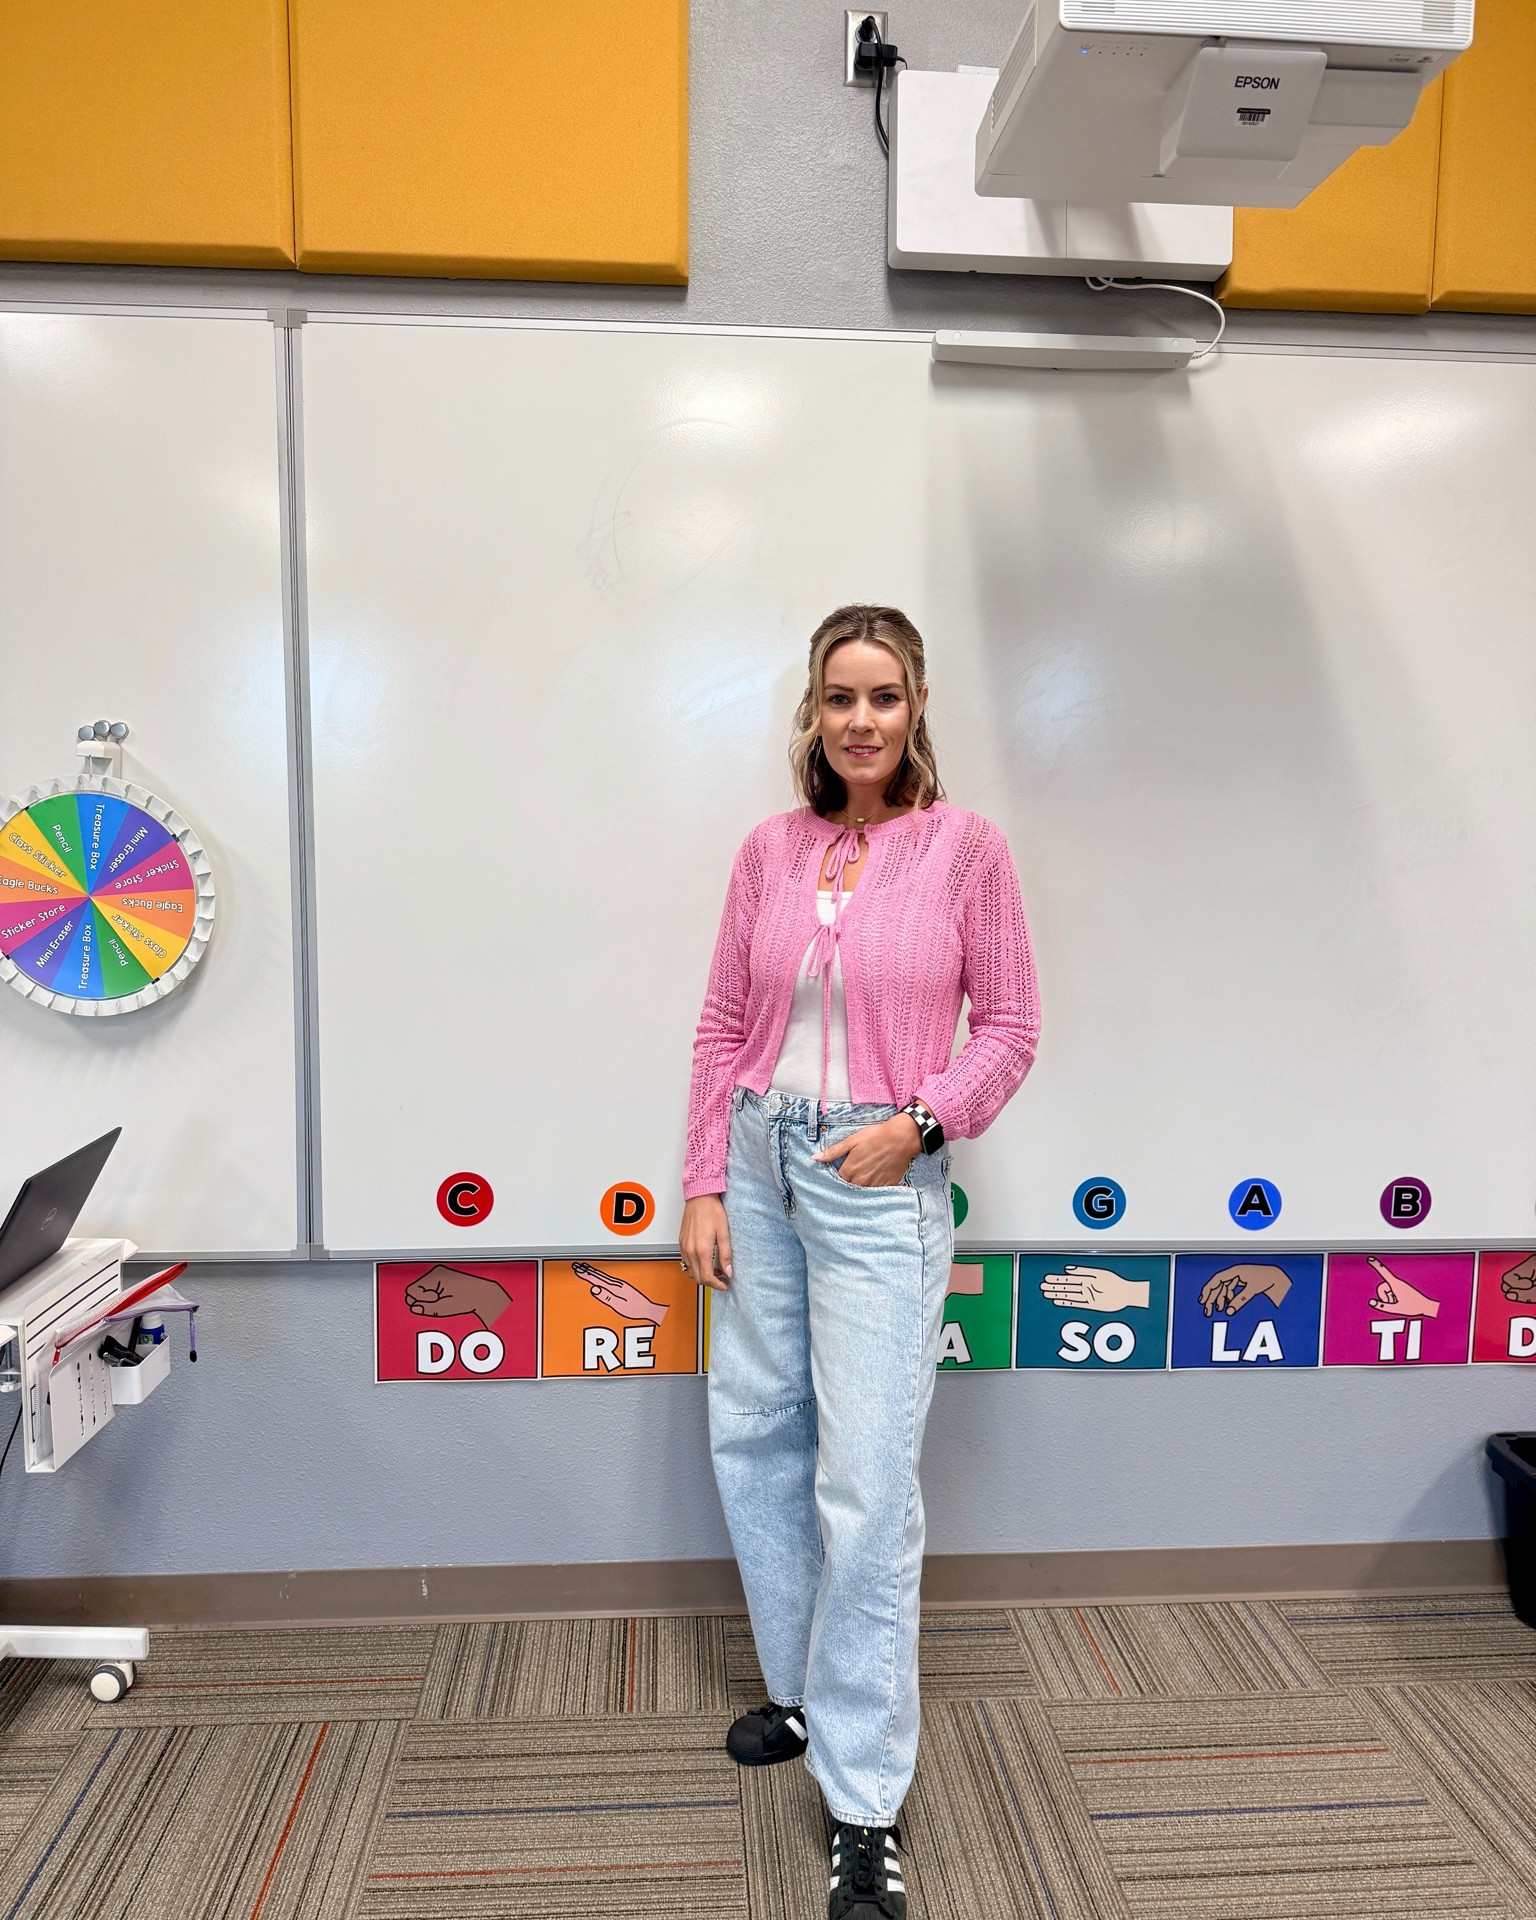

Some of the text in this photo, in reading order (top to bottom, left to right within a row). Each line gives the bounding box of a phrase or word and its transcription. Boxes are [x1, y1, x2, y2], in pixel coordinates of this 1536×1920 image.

[1234, 75, 1280, 90] EPSON
[9, 832, 67, 878] Class Sticker
[52, 823, 72, 853] Pencil
[90, 803, 105, 870] Treasure Box
[108, 826, 148, 873] Mini Eraser
[27, 880, 58, 895] Bucks
[114, 859, 180, 889] Sticker Store
[1, 904, 66, 939] Sticker Store
[122, 898, 183, 913] Eagle Bucks
[35, 920, 74, 969] Mini Eraser
[78, 924, 92, 990] Treasure Box
[108, 938, 129, 967] Pencil
[111, 914, 167, 959] Class Sticker
[446, 1181, 481, 1218] C
[612, 1190, 647, 1226] D
[1082, 1185, 1116, 1221] G
[1235, 1183, 1274, 1217] A
[1390, 1185, 1422, 1219] B
[416, 1329, 506, 1375] DO
[582, 1324, 657, 1373] RE
[936, 1320, 974, 1366] A
[1056, 1319, 1137, 1364] SO
[1210, 1319, 1285, 1363] LA
[1369, 1317, 1424, 1361] TI
[1507, 1315, 1536, 1359] D
